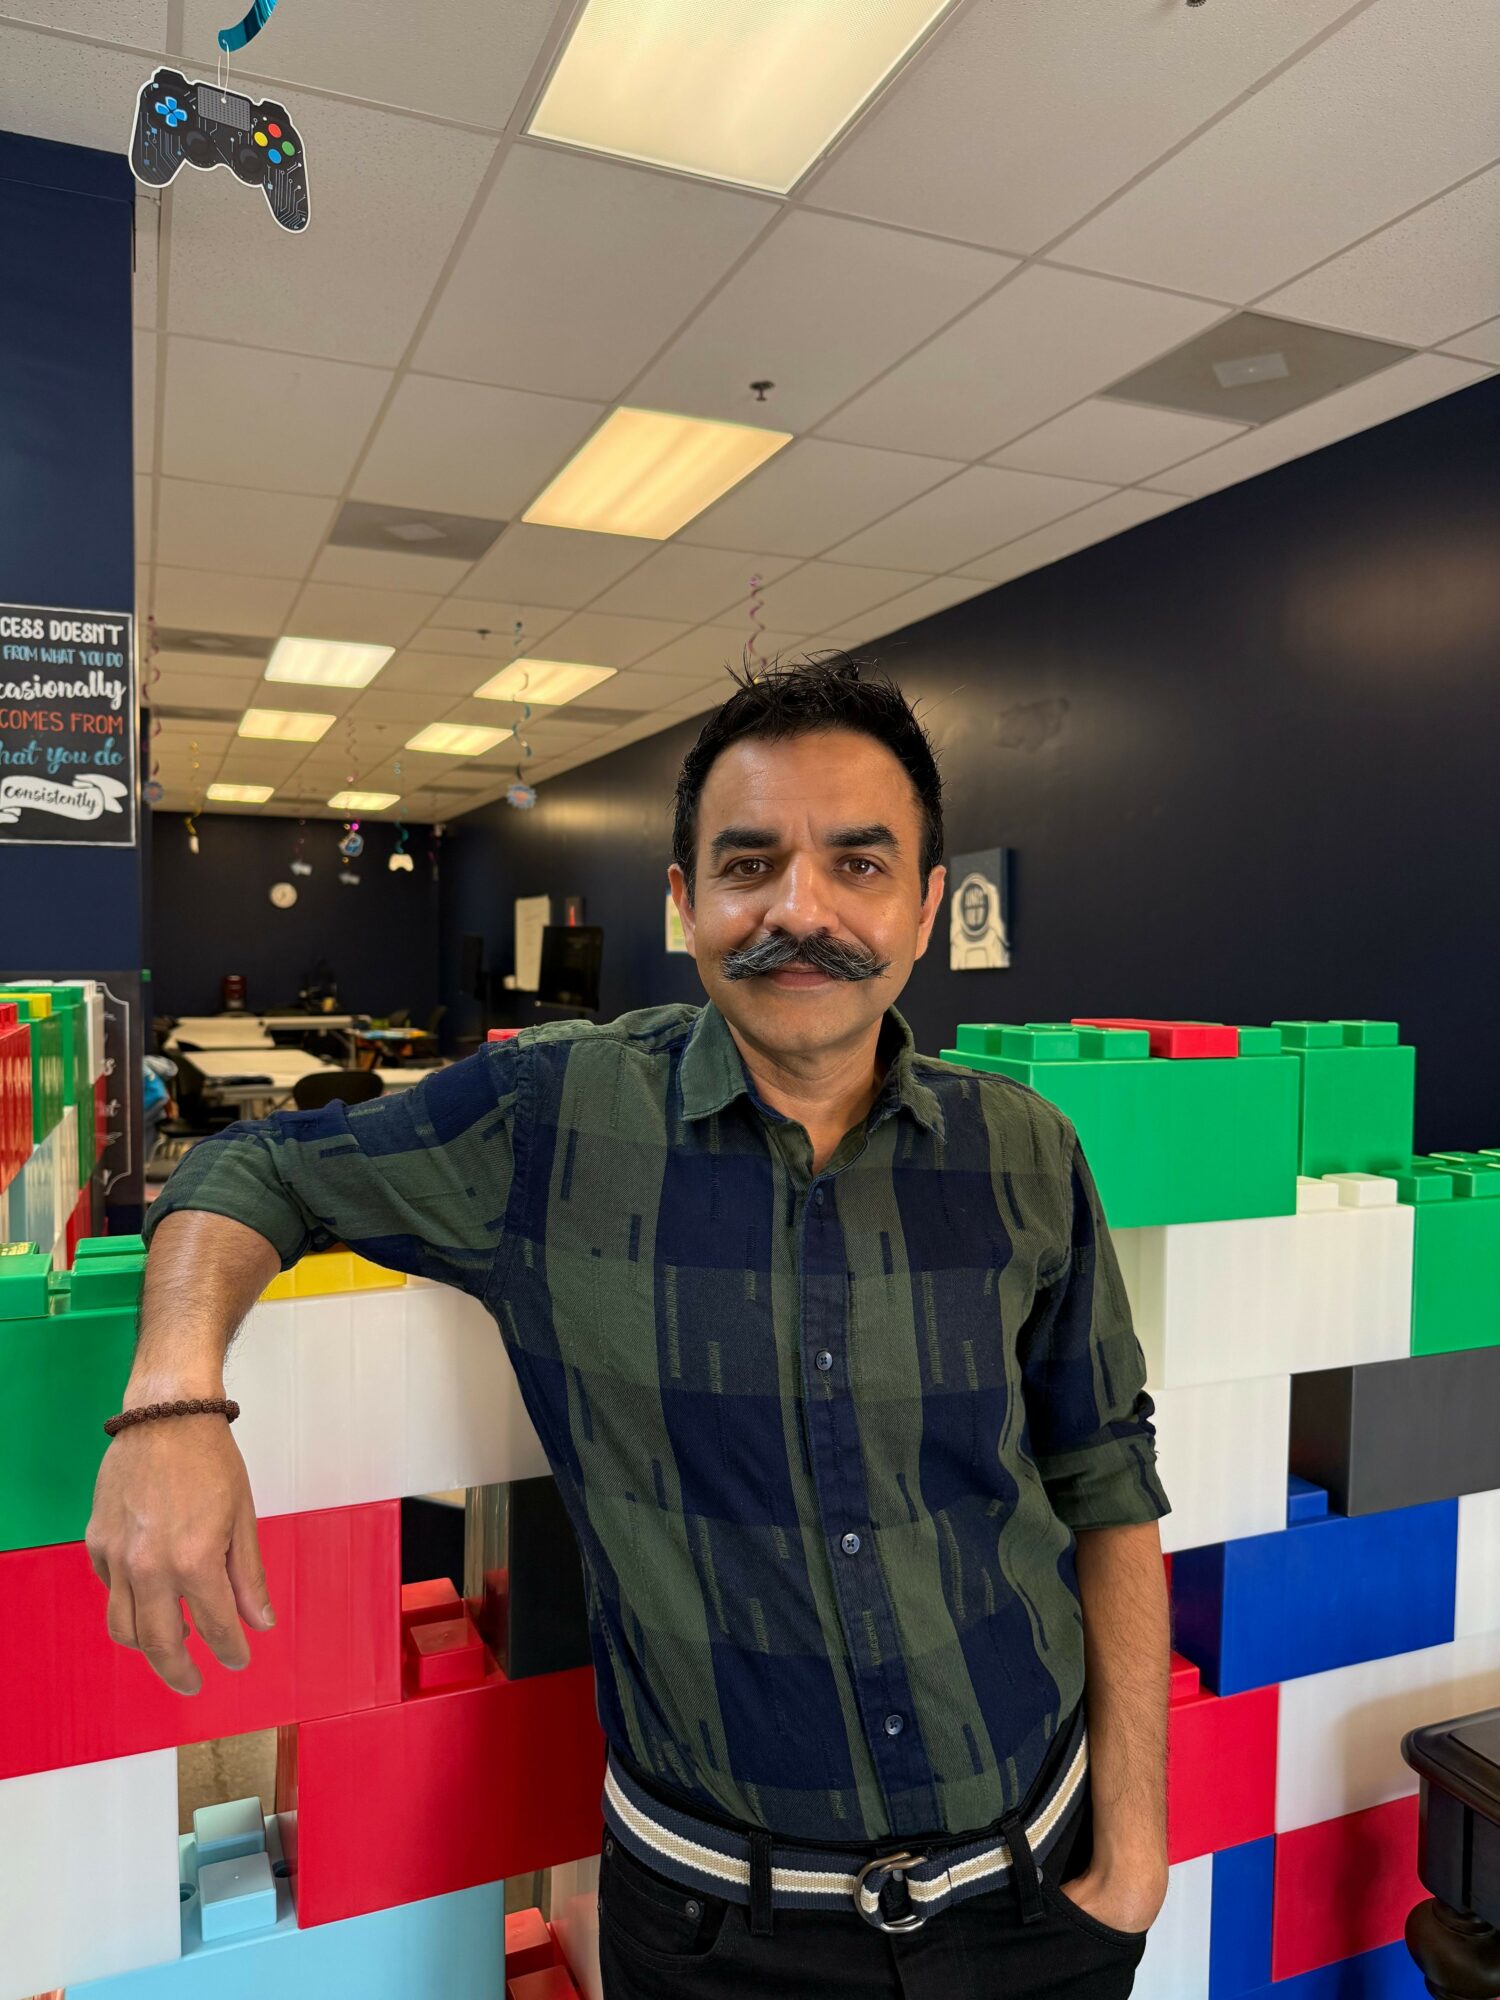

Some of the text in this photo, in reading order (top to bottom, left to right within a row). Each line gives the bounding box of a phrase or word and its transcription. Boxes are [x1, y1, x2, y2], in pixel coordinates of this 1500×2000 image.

[3, 645, 124, 668] FROM WHAT YOU DO
[0, 708, 123, 735] COMES FROM
[46, 746, 90, 774] you
[94, 737, 126, 766] do
[4, 785, 96, 815] consistently
